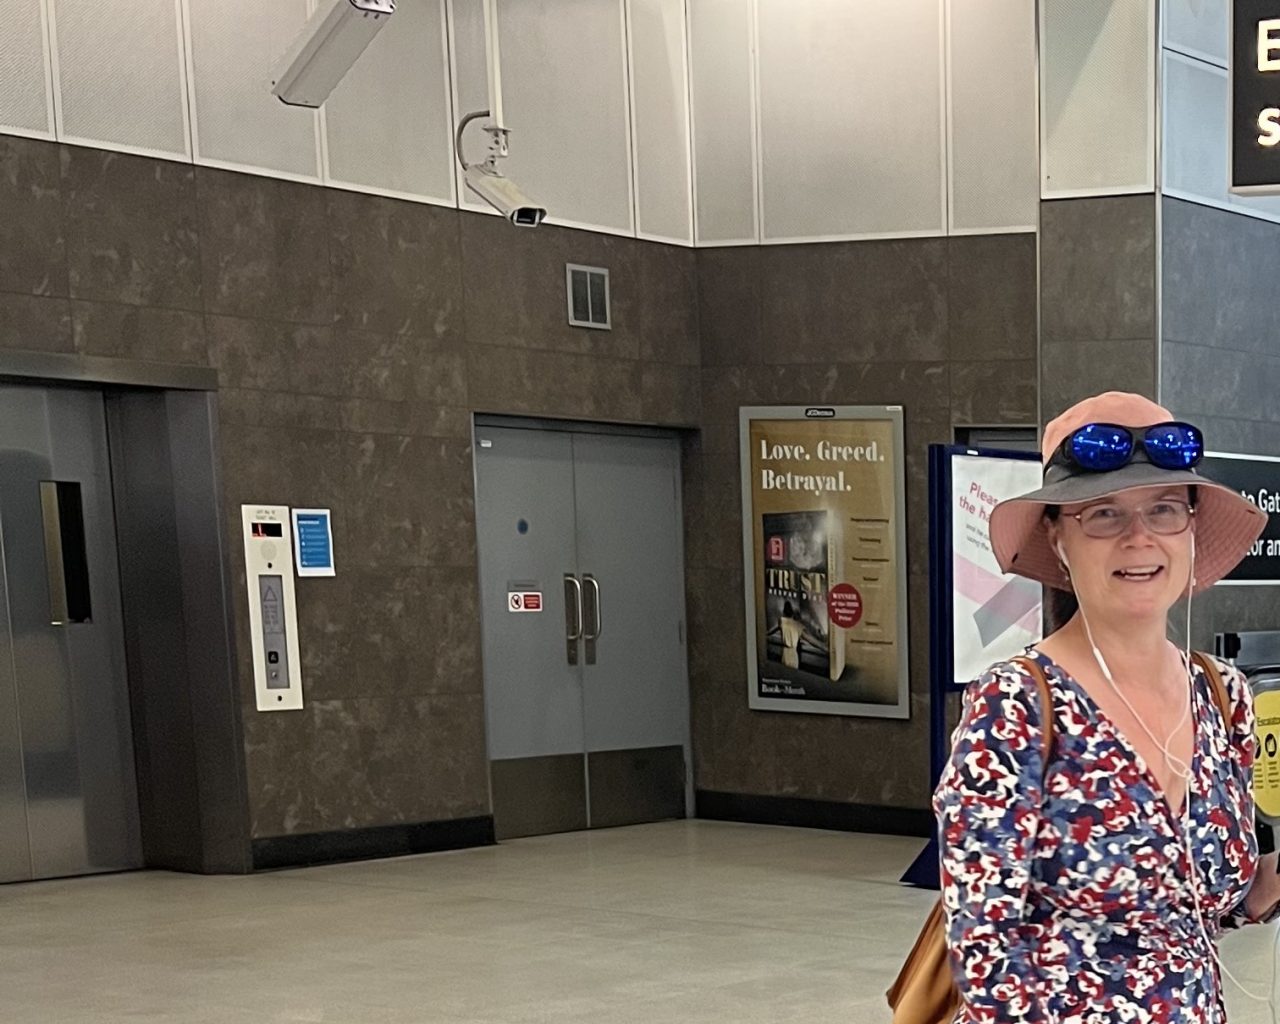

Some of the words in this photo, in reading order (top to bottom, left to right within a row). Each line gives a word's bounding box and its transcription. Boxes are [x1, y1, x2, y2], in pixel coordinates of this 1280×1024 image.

[761, 439, 811, 460] Love.
[817, 440, 885, 462] Greed.
[761, 469, 852, 496] Betrayal.
[969, 481, 999, 507] Pleas
[959, 496, 977, 515] the
[765, 568, 826, 594] TRUST
